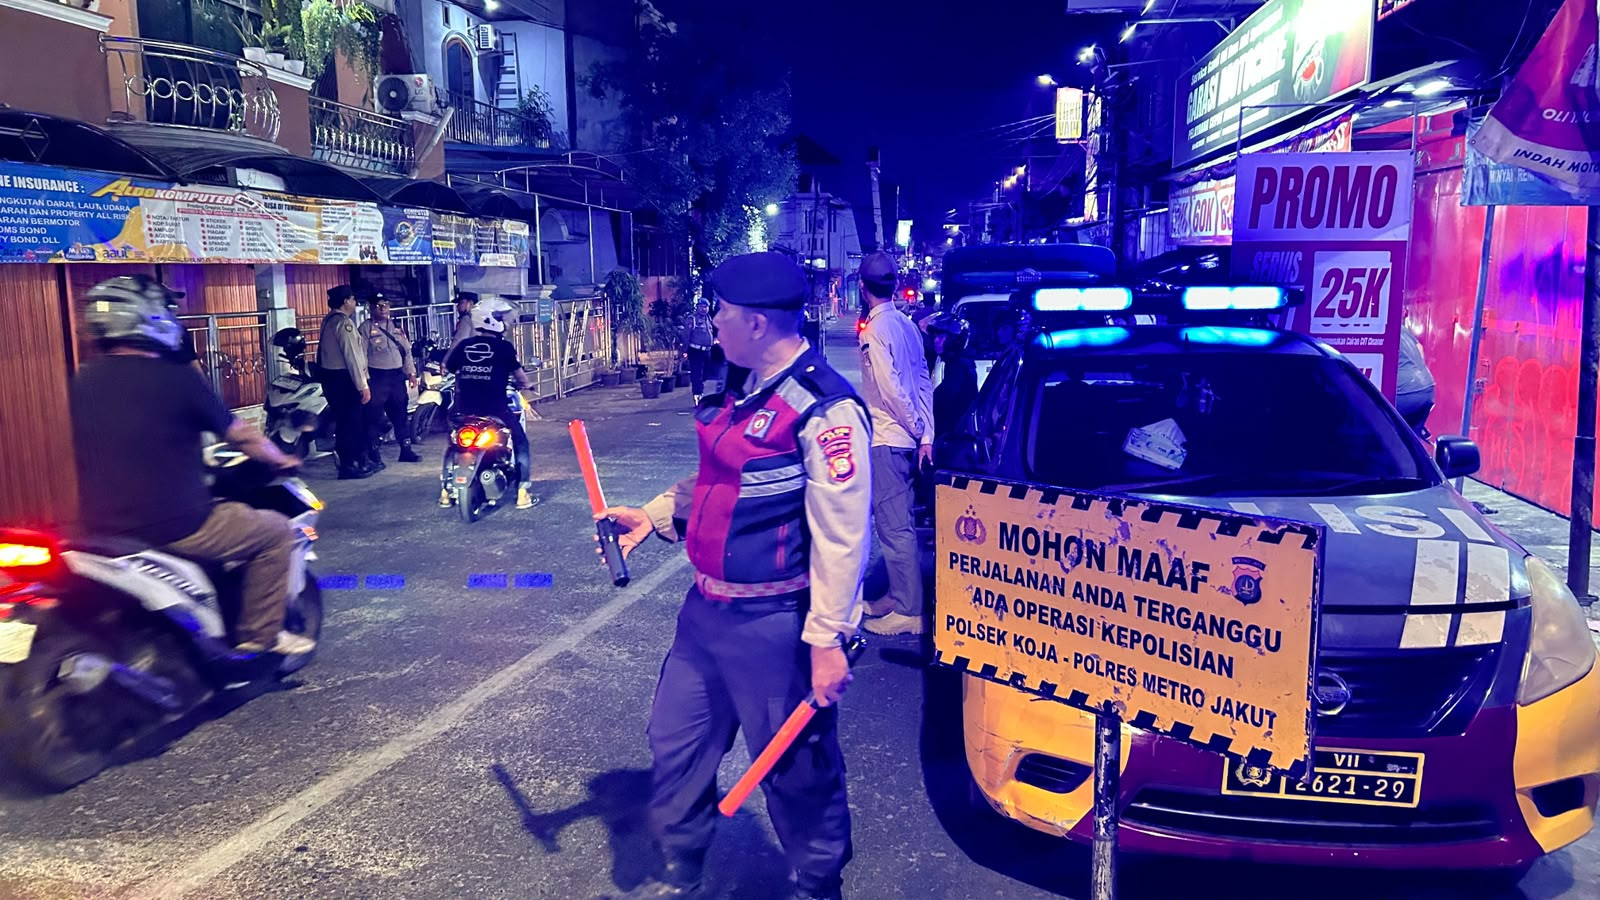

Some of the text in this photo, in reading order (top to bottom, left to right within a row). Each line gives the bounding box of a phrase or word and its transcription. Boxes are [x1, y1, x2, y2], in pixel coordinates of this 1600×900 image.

[1513, 148, 1566, 168] INDAH
[103, 203, 131, 212] UDARA
[1247, 164, 1399, 230] PROMO
[29, 209, 49, 217] DAN
[50, 210, 95, 220] PROPERTY
[95, 212, 112, 220] ALL
[30, 218, 81, 227] BERMOTOR
[1192, 197, 1214, 232] 60K
[19, 226, 47, 235] BOND
[42, 236, 61, 244] DLL
[1250, 251, 1303, 283] SERVIS
[1314, 267, 1390, 319] 25K
[461, 365, 493, 373] repsol
[999, 521, 1210, 595] MOHON MAAF
[949, 551, 1282, 653] PERJALANAN ANDA TERGANGGU
[971, 586, 1234, 679] ADA OPERASI KEPOLISIAN
[946, 614, 1007, 647] POLSEK
[1013, 634, 1058, 664] KOJA
[1073, 652, 1137, 688] POLRES
[1142, 671, 1206, 709] METRO
[1210, 695, 1278, 731] JAKUT
[1334, 753, 1360, 768] VII
